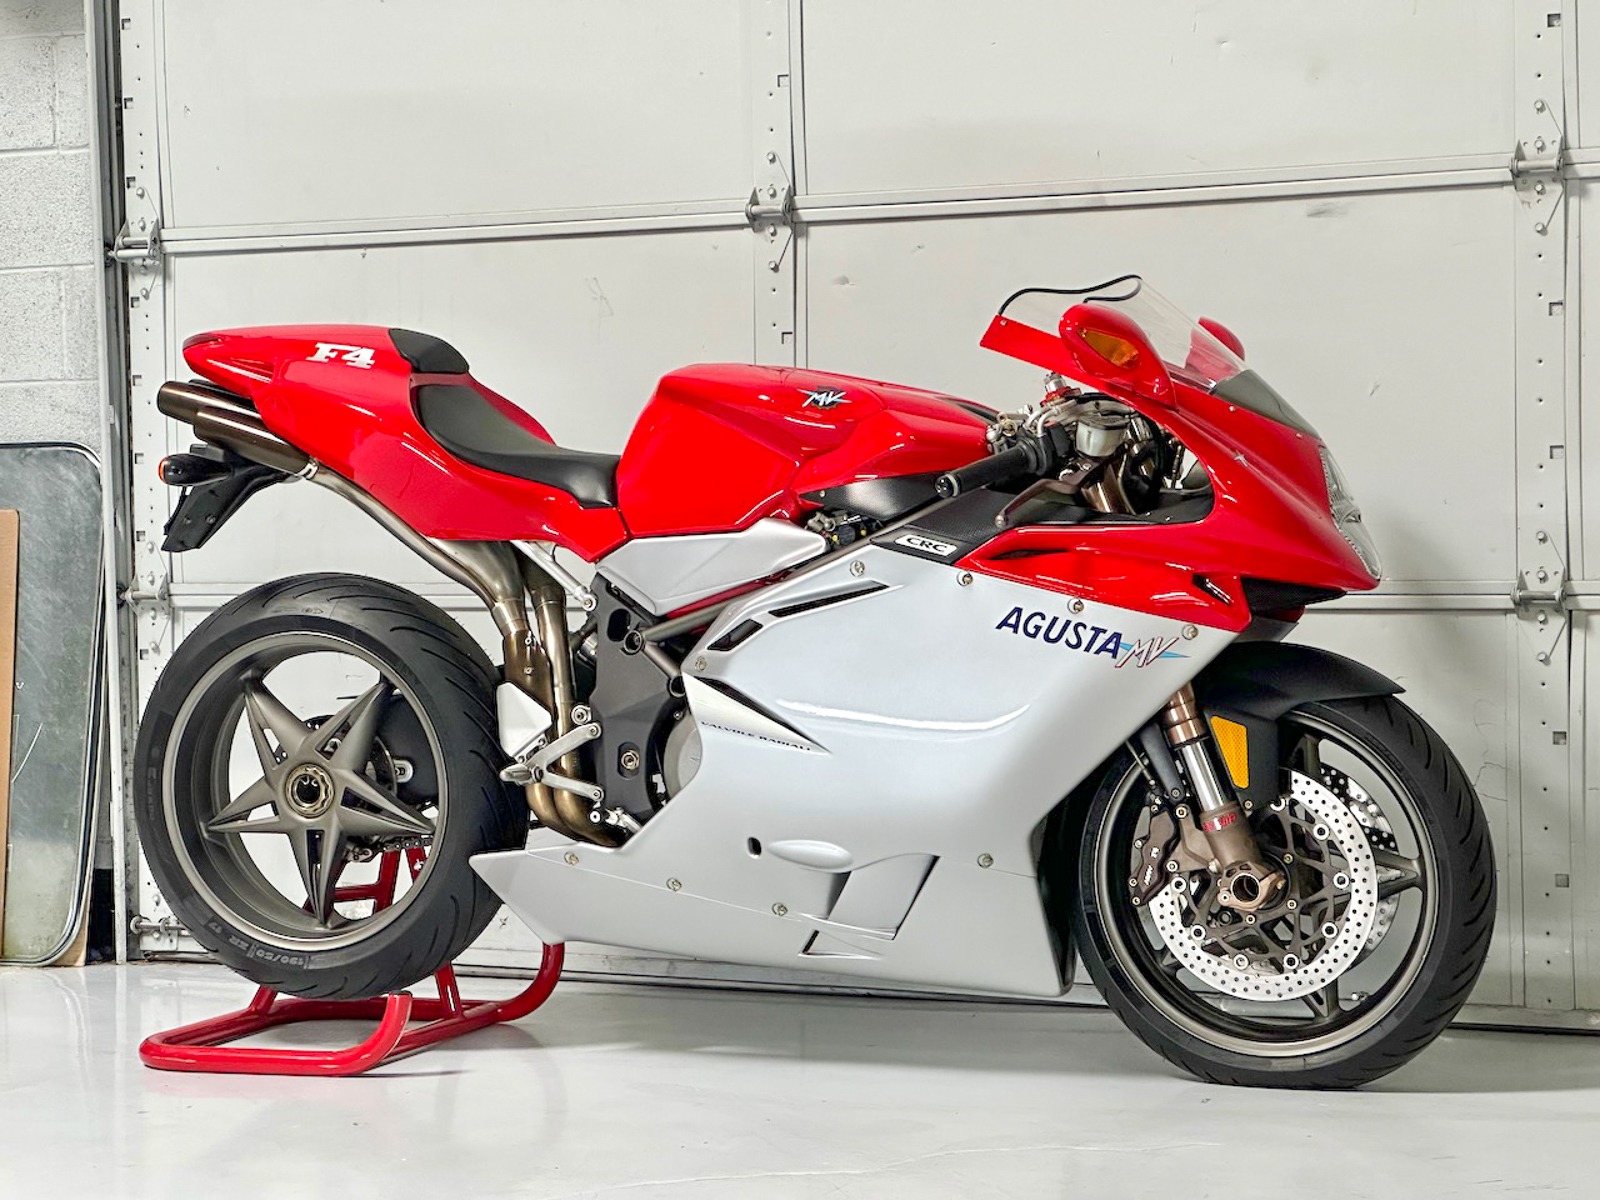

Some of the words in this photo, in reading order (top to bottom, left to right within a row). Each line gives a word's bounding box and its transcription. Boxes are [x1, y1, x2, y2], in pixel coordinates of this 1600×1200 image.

[305, 342, 376, 369] F4
[801, 390, 847, 408] MV
[906, 537, 948, 553] CRC
[995, 606, 1124, 660] AGUSTA
[1114, 636, 1180, 668] MV
